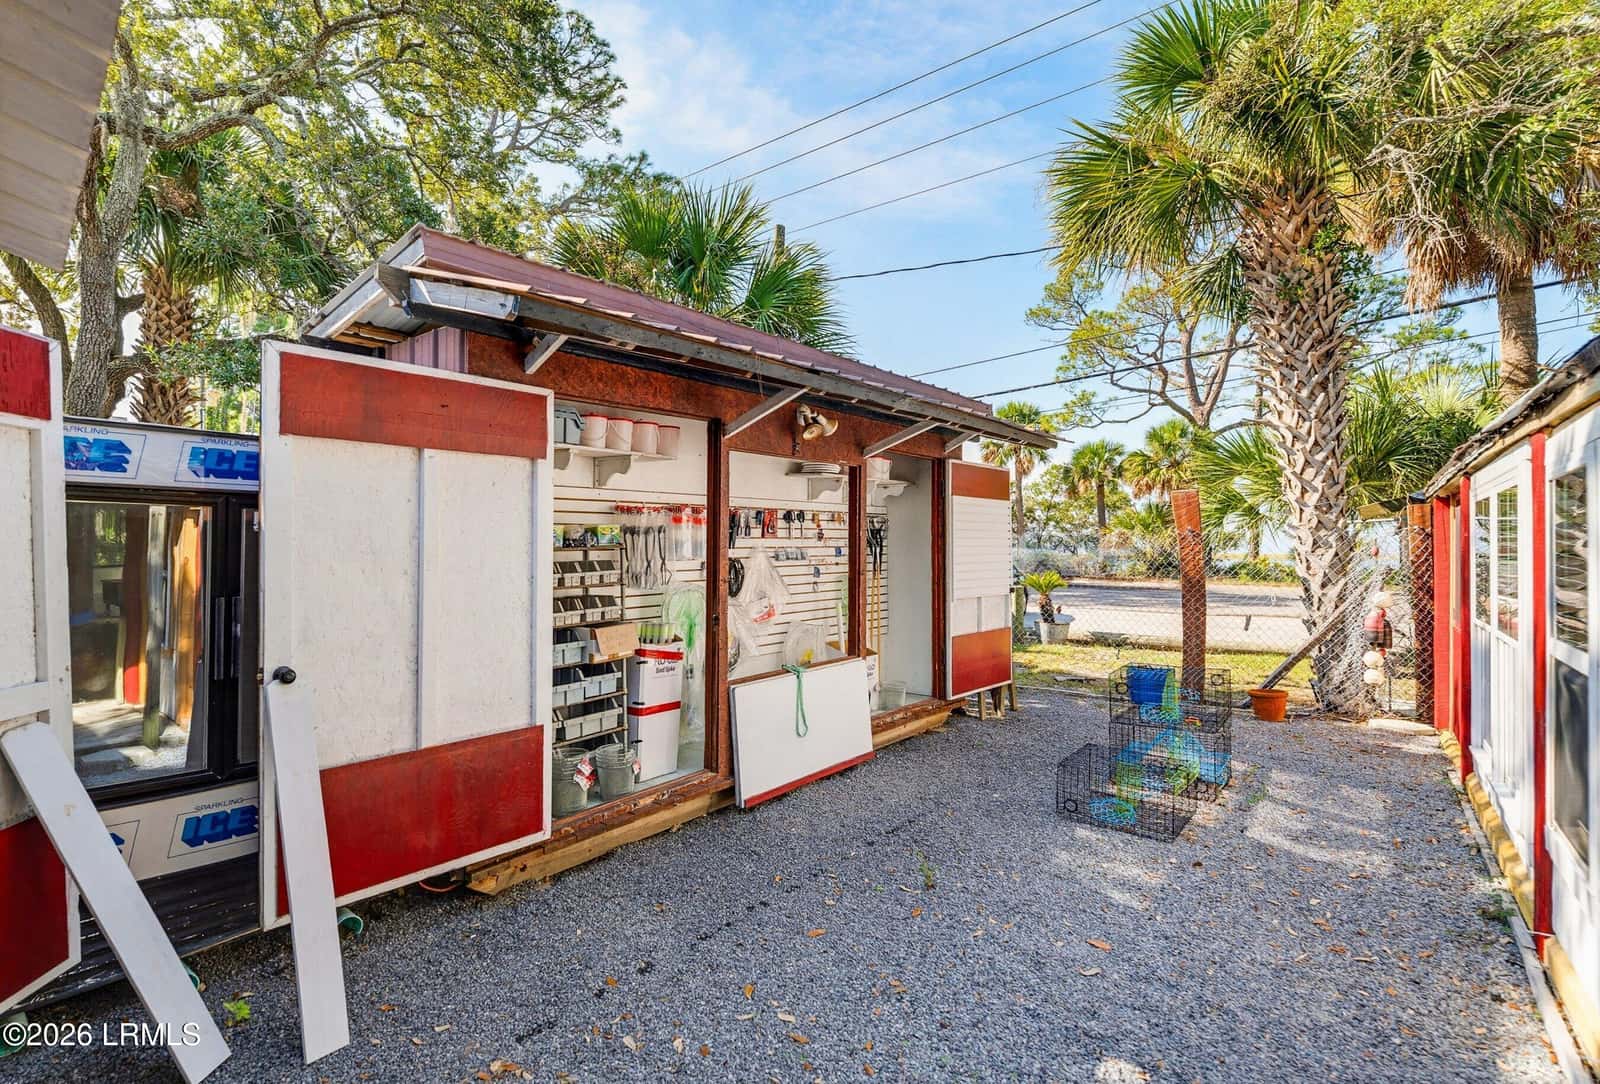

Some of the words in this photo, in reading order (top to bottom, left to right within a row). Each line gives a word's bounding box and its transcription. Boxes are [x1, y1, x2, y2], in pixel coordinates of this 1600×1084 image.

[64, 424, 109, 435] ARKLING
[64, 435, 132, 473] CE
[200, 436, 249, 448] SPARKLING
[188, 446, 259, 481] ICE
[194, 797, 242, 811] SPARKLING
[181, 805, 259, 848] ICE
